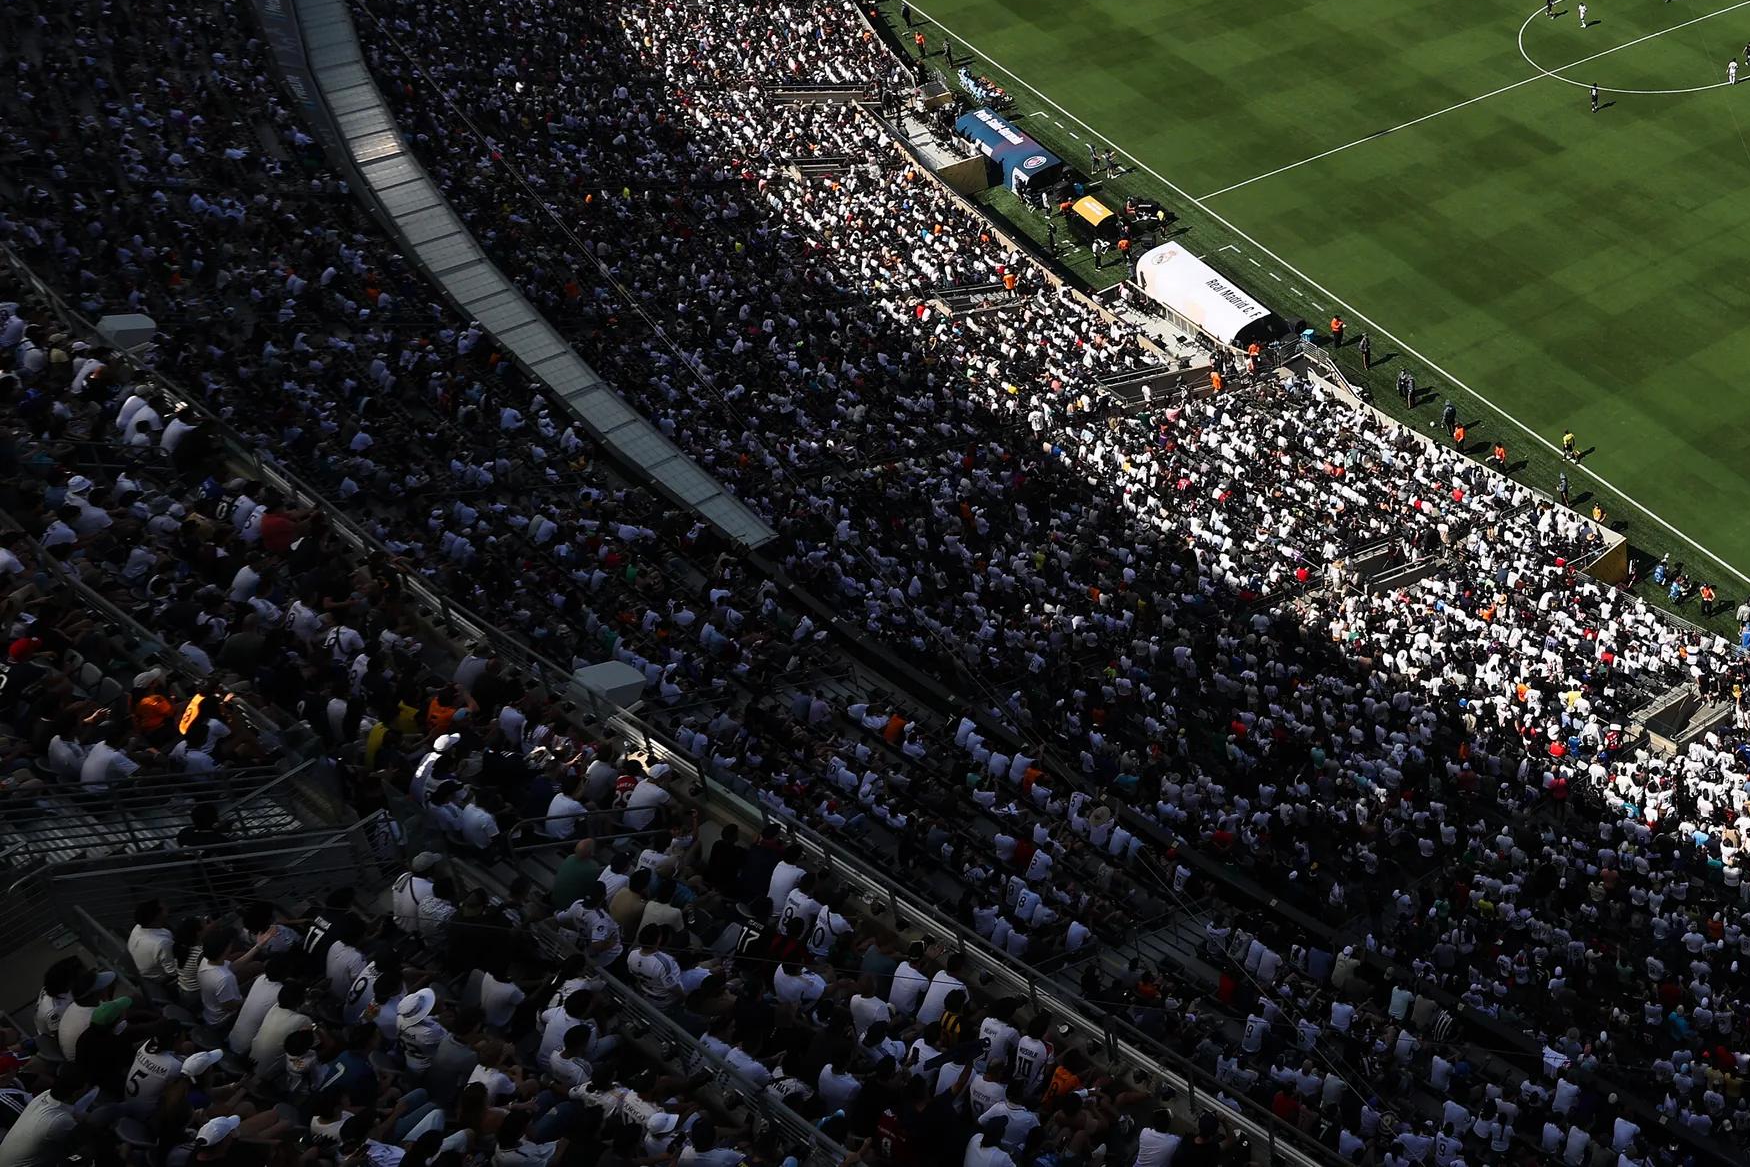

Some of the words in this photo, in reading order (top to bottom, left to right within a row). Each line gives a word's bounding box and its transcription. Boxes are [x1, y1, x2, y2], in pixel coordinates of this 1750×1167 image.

[1206, 278, 1224, 293] Real
[1220, 289, 1249, 310] Madrid
[1018, 896, 1026, 908] 8
[303, 924, 326, 954] 17
[737, 926, 761, 953] 17
[347, 975, 367, 1004] 9
[126, 1069, 148, 1098] 5
